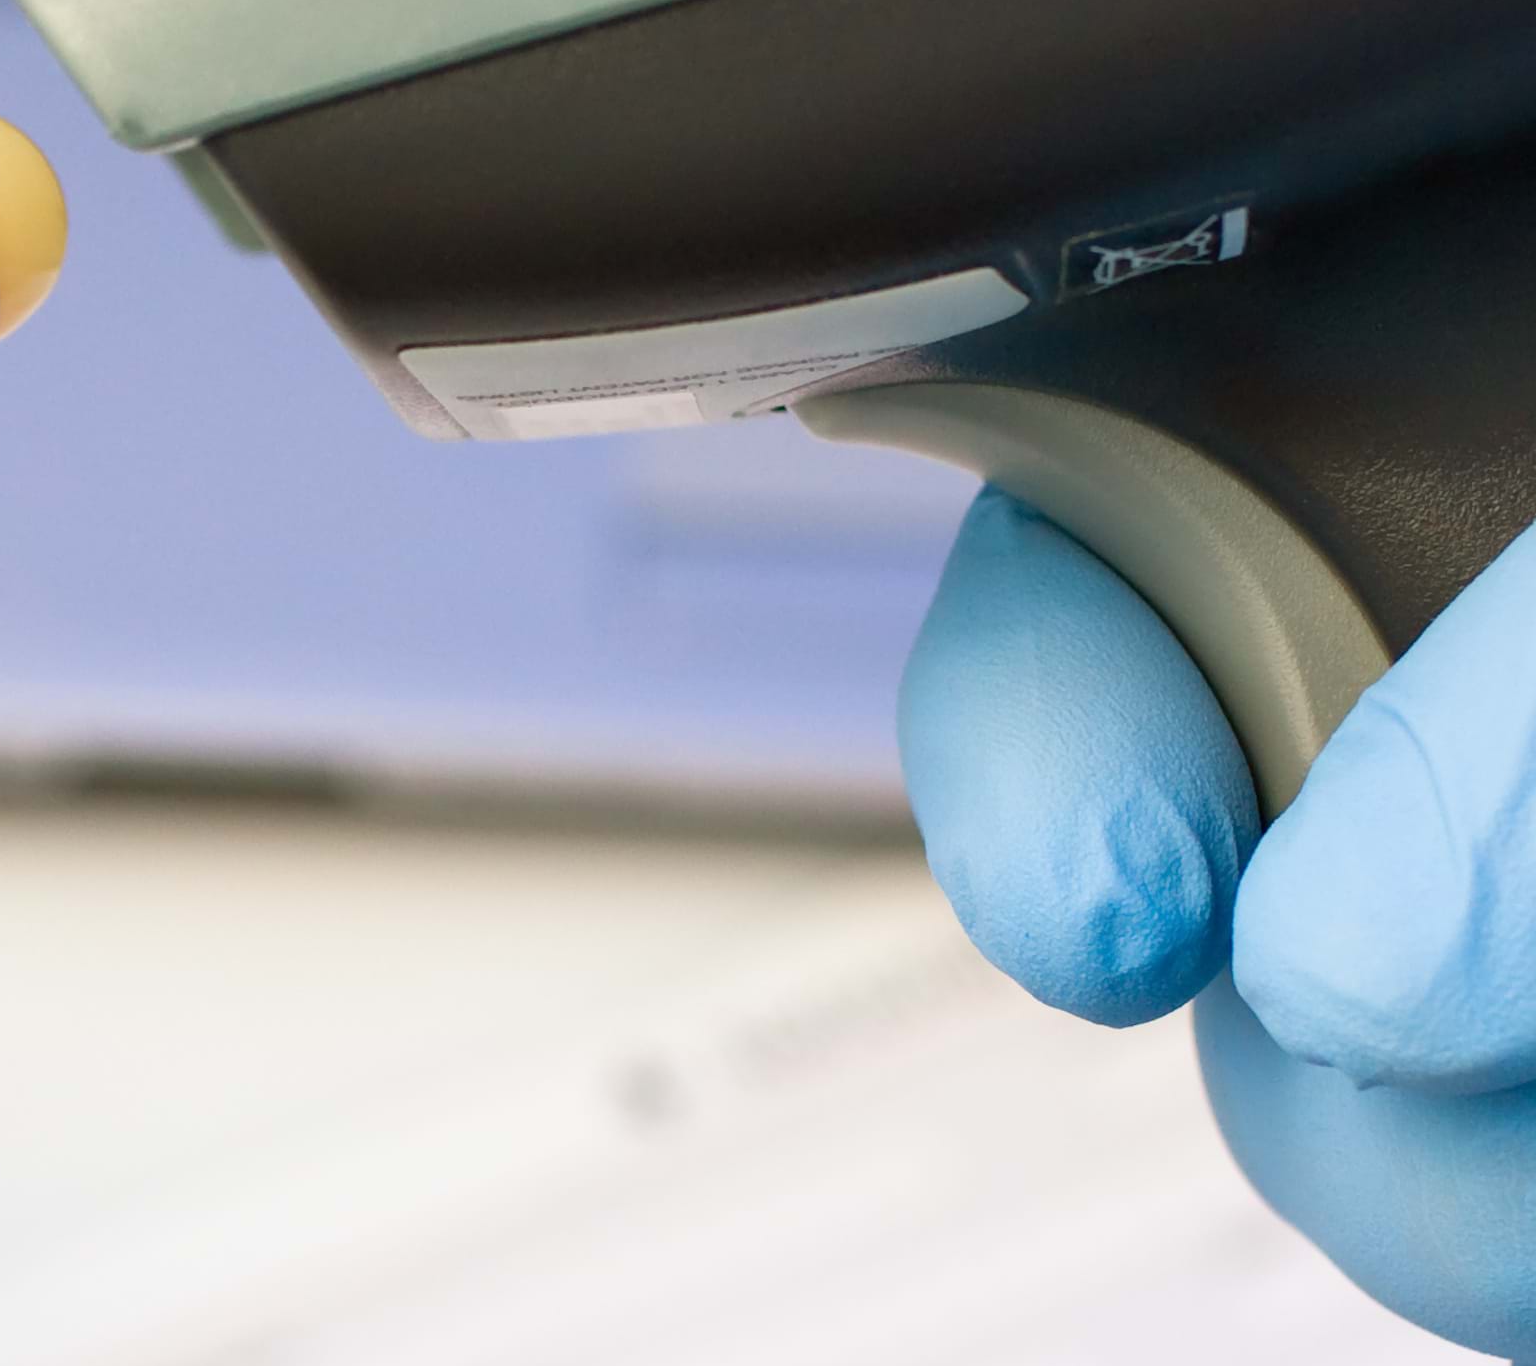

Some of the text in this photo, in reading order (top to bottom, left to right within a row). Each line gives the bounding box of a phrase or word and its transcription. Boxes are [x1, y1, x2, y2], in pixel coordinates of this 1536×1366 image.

[736, 351, 858, 372] PACKAGE
[673, 369, 726, 381] FOR
[739, 362, 837, 381] CLASS
[569, 377, 664, 392] PATENT
[647, 381, 704, 393] LED
[455, 389, 557, 400] LISTING
[496, 389, 637, 407] PRODUCT
